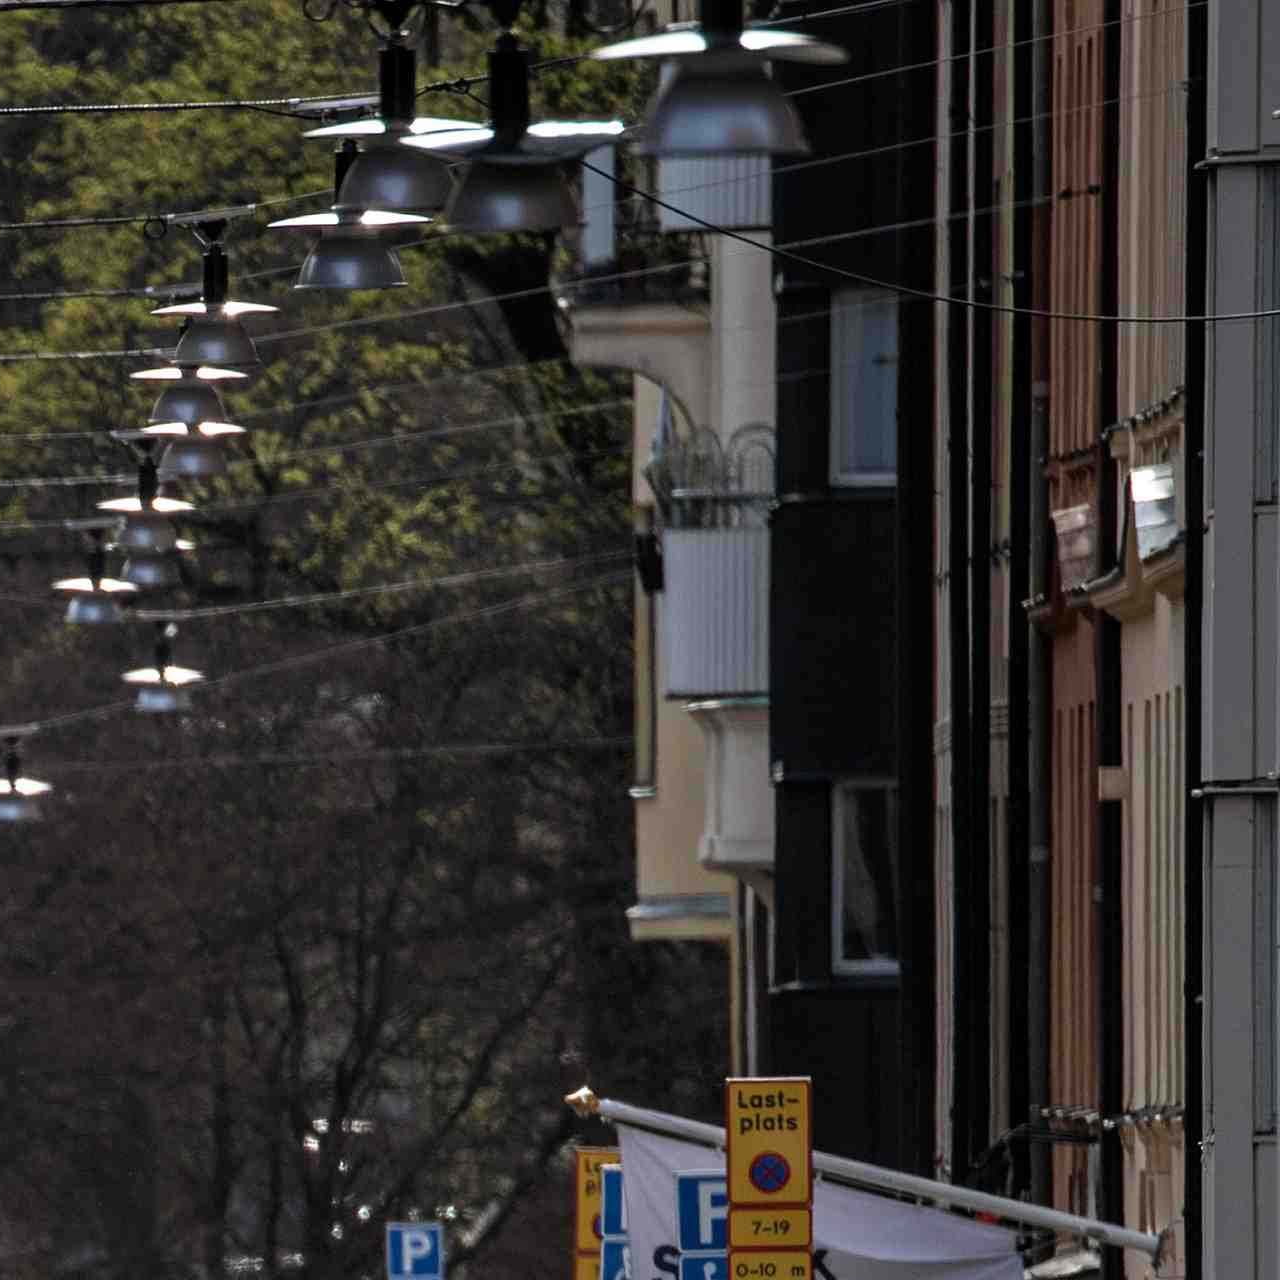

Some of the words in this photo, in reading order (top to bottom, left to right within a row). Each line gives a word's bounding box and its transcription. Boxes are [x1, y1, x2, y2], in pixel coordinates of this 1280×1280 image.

[738, 1089, 800, 1109] Last-
[740, 1113, 798, 1135] plats
[752, 1220, 790, 1235] 7-19
[736, 1263, 776, 1278] 0-10
[791, 1265, 805, 1277] m
